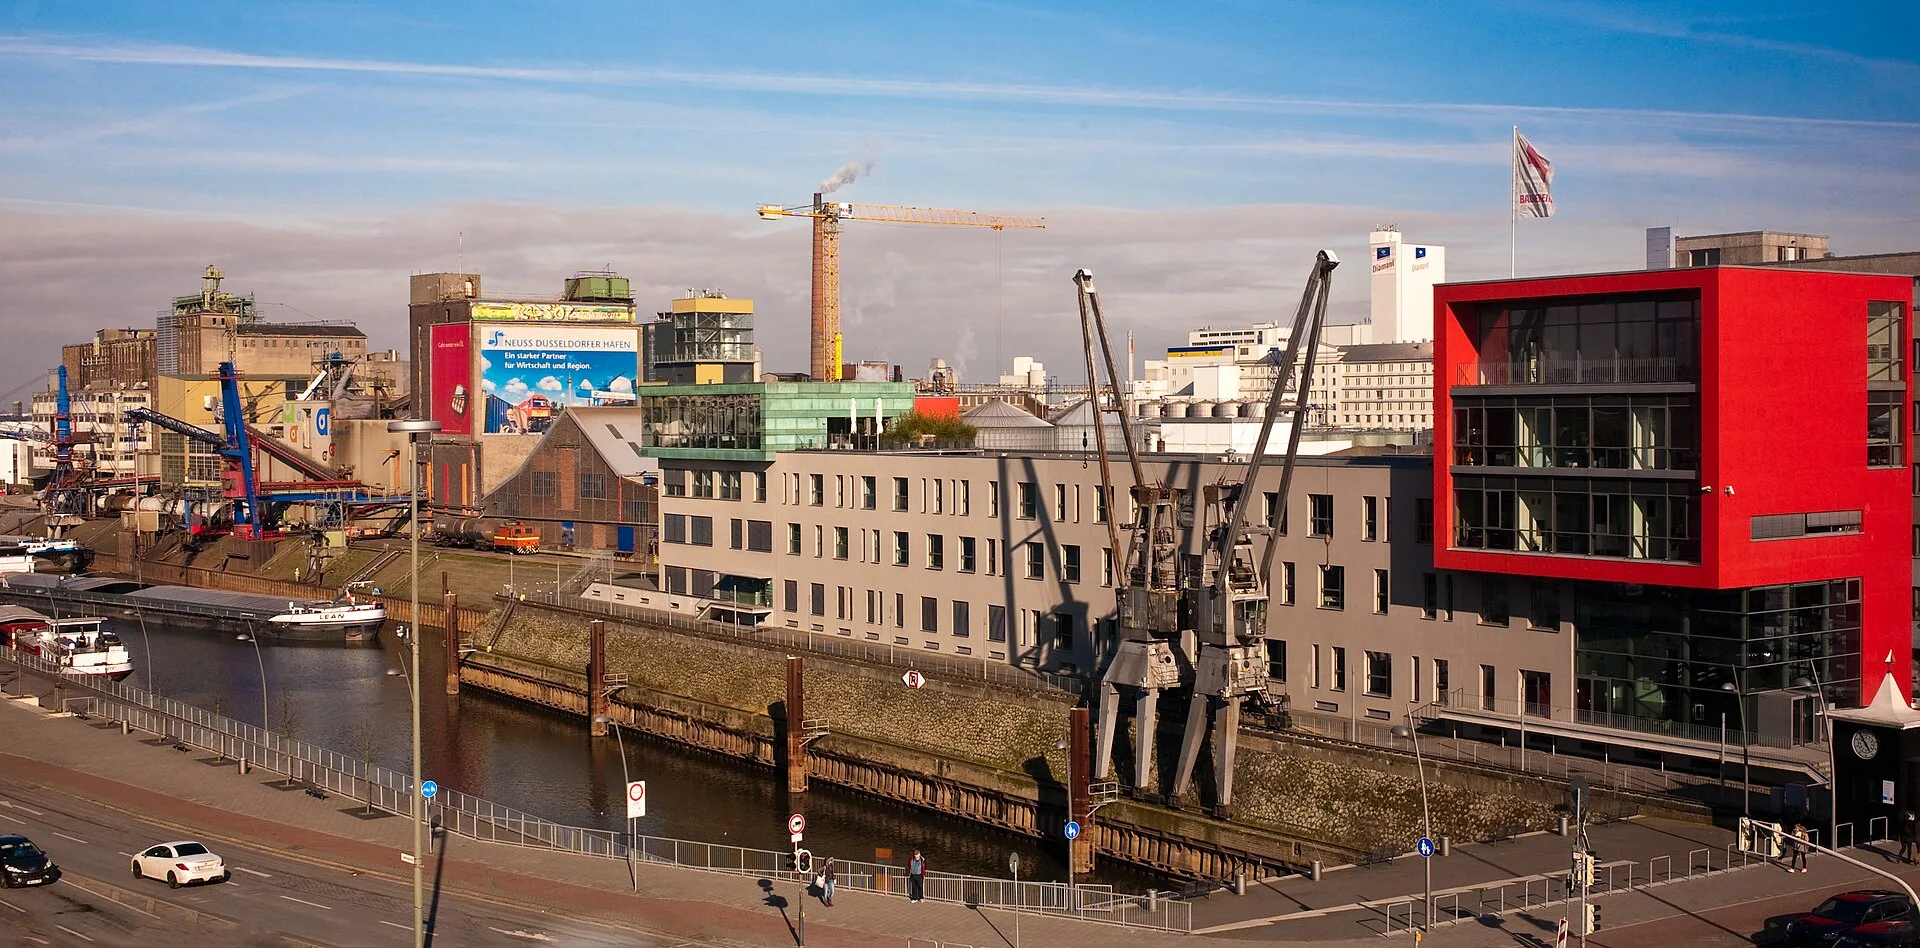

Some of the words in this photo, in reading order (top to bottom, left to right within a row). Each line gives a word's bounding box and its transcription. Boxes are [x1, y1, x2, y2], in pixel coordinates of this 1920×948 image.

[1372, 259, 1395, 273] Diamant
[504, 339, 533, 347] NEUSS
[504, 352, 516, 360] Ein
[517, 352, 540, 360] starker
[541, 352, 567, 361] Partner
[504, 362, 515, 370] für
[515, 362, 551, 370] Wirtschaft
[552, 362, 566, 370] und
[567, 362, 592, 371] Region.
